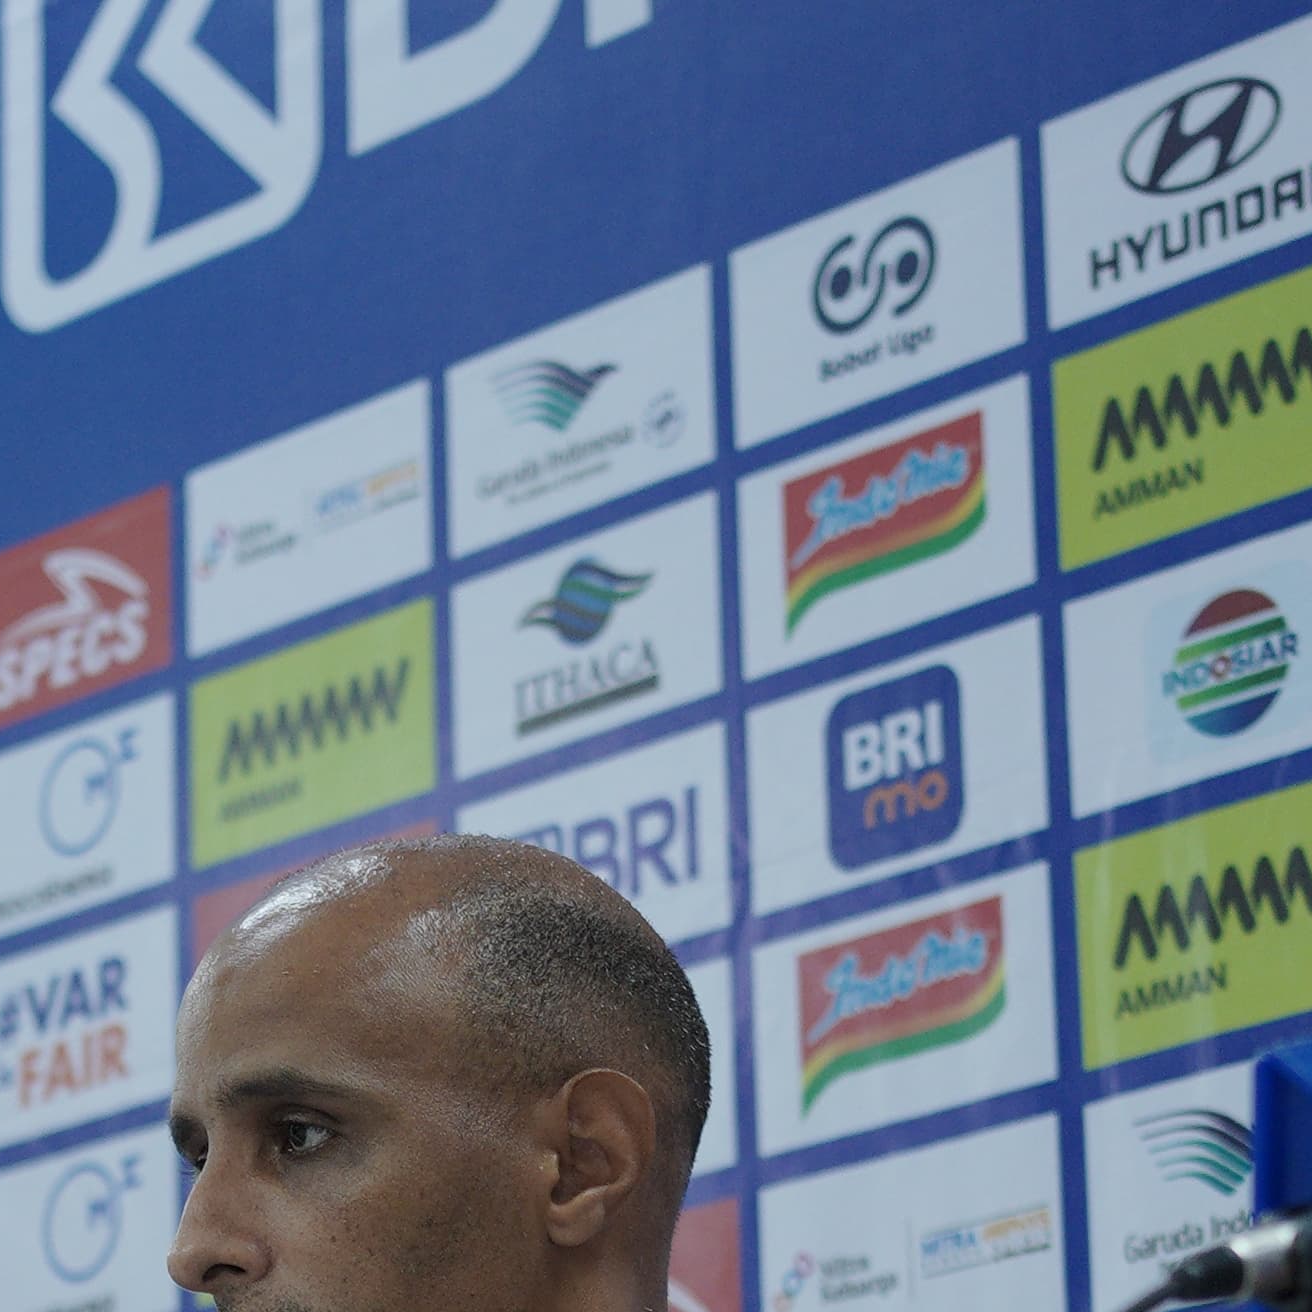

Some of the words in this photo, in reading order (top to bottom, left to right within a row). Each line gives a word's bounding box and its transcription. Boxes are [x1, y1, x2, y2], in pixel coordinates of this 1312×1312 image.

[1094, 457, 1206, 521] AMMAN
[515, 637, 660, 722] ITHACA
[1161, 632, 1299, 697] INDOSIAR
[843, 700, 944, 792] BRI
[863, 769, 950, 832] mo
[1114, 961, 1228, 1021] AMMAN
[18, 1023, 130, 1108] FAIR
